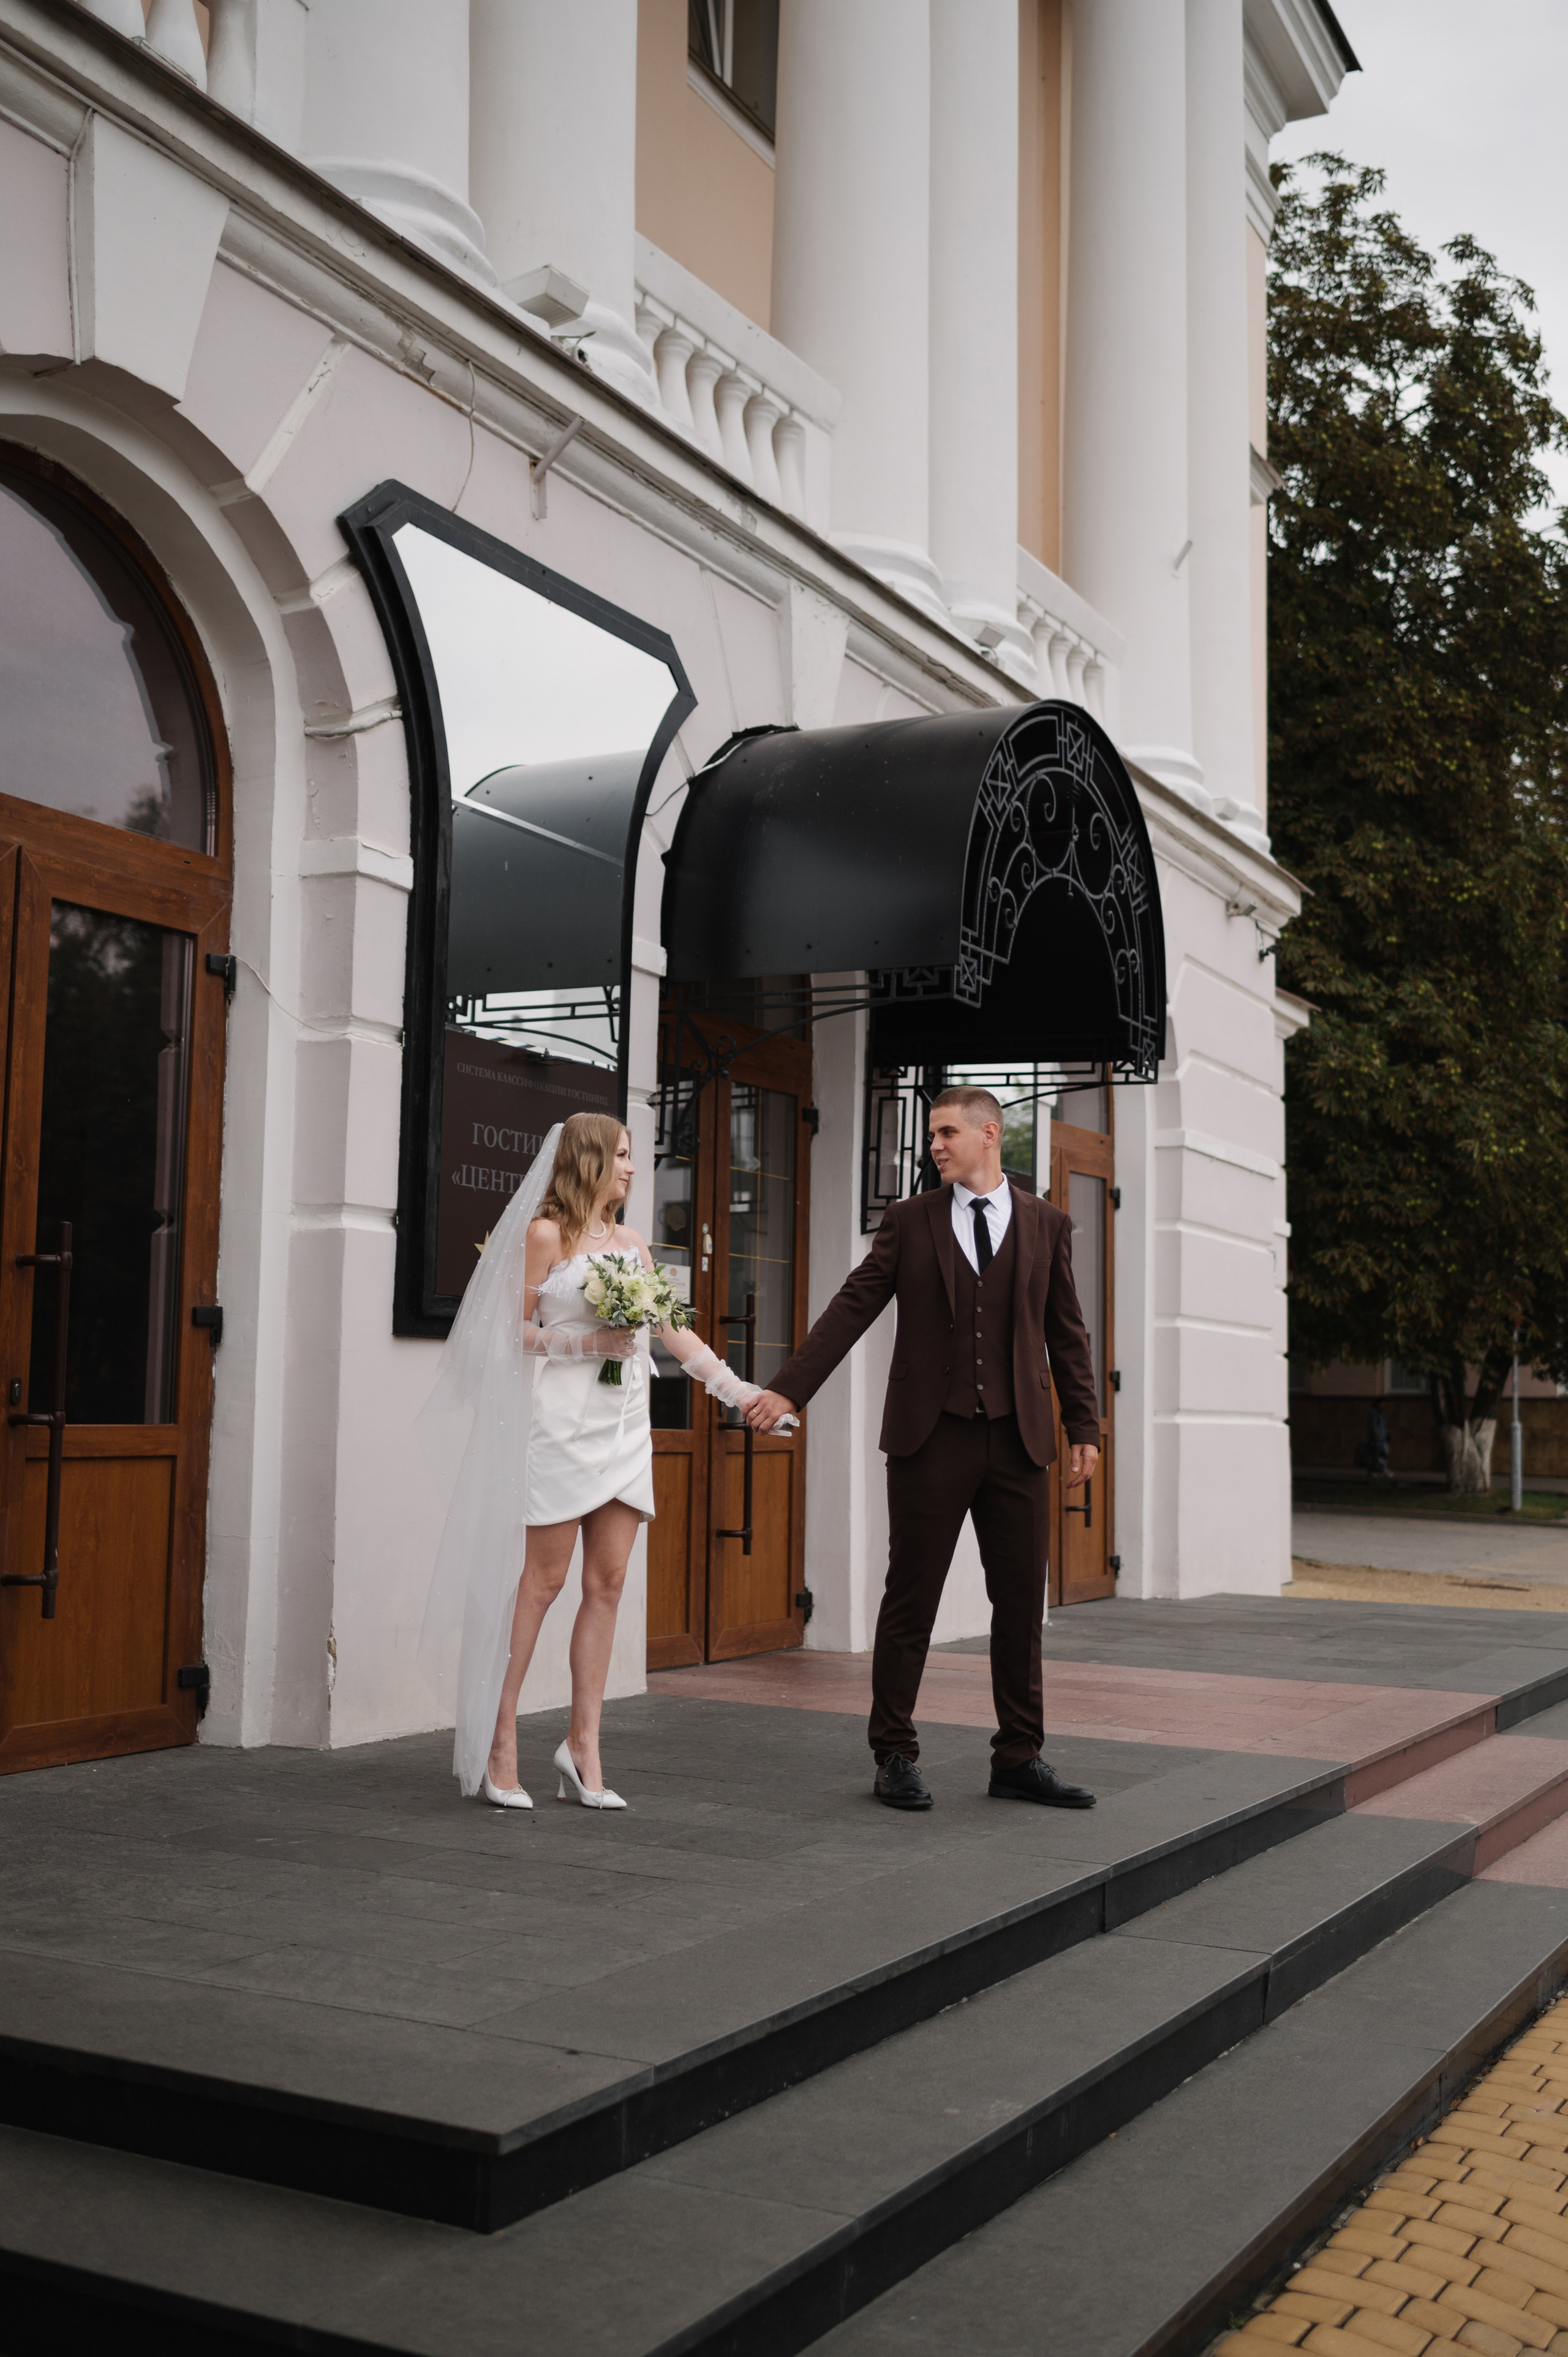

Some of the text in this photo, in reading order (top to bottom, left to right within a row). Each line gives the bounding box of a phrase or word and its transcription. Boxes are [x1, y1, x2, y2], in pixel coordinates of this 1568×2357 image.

[457, 1062, 608, 1106] СИСТЕМА КЛАССИФИКАЦИИ ГОСТИНИЦ
